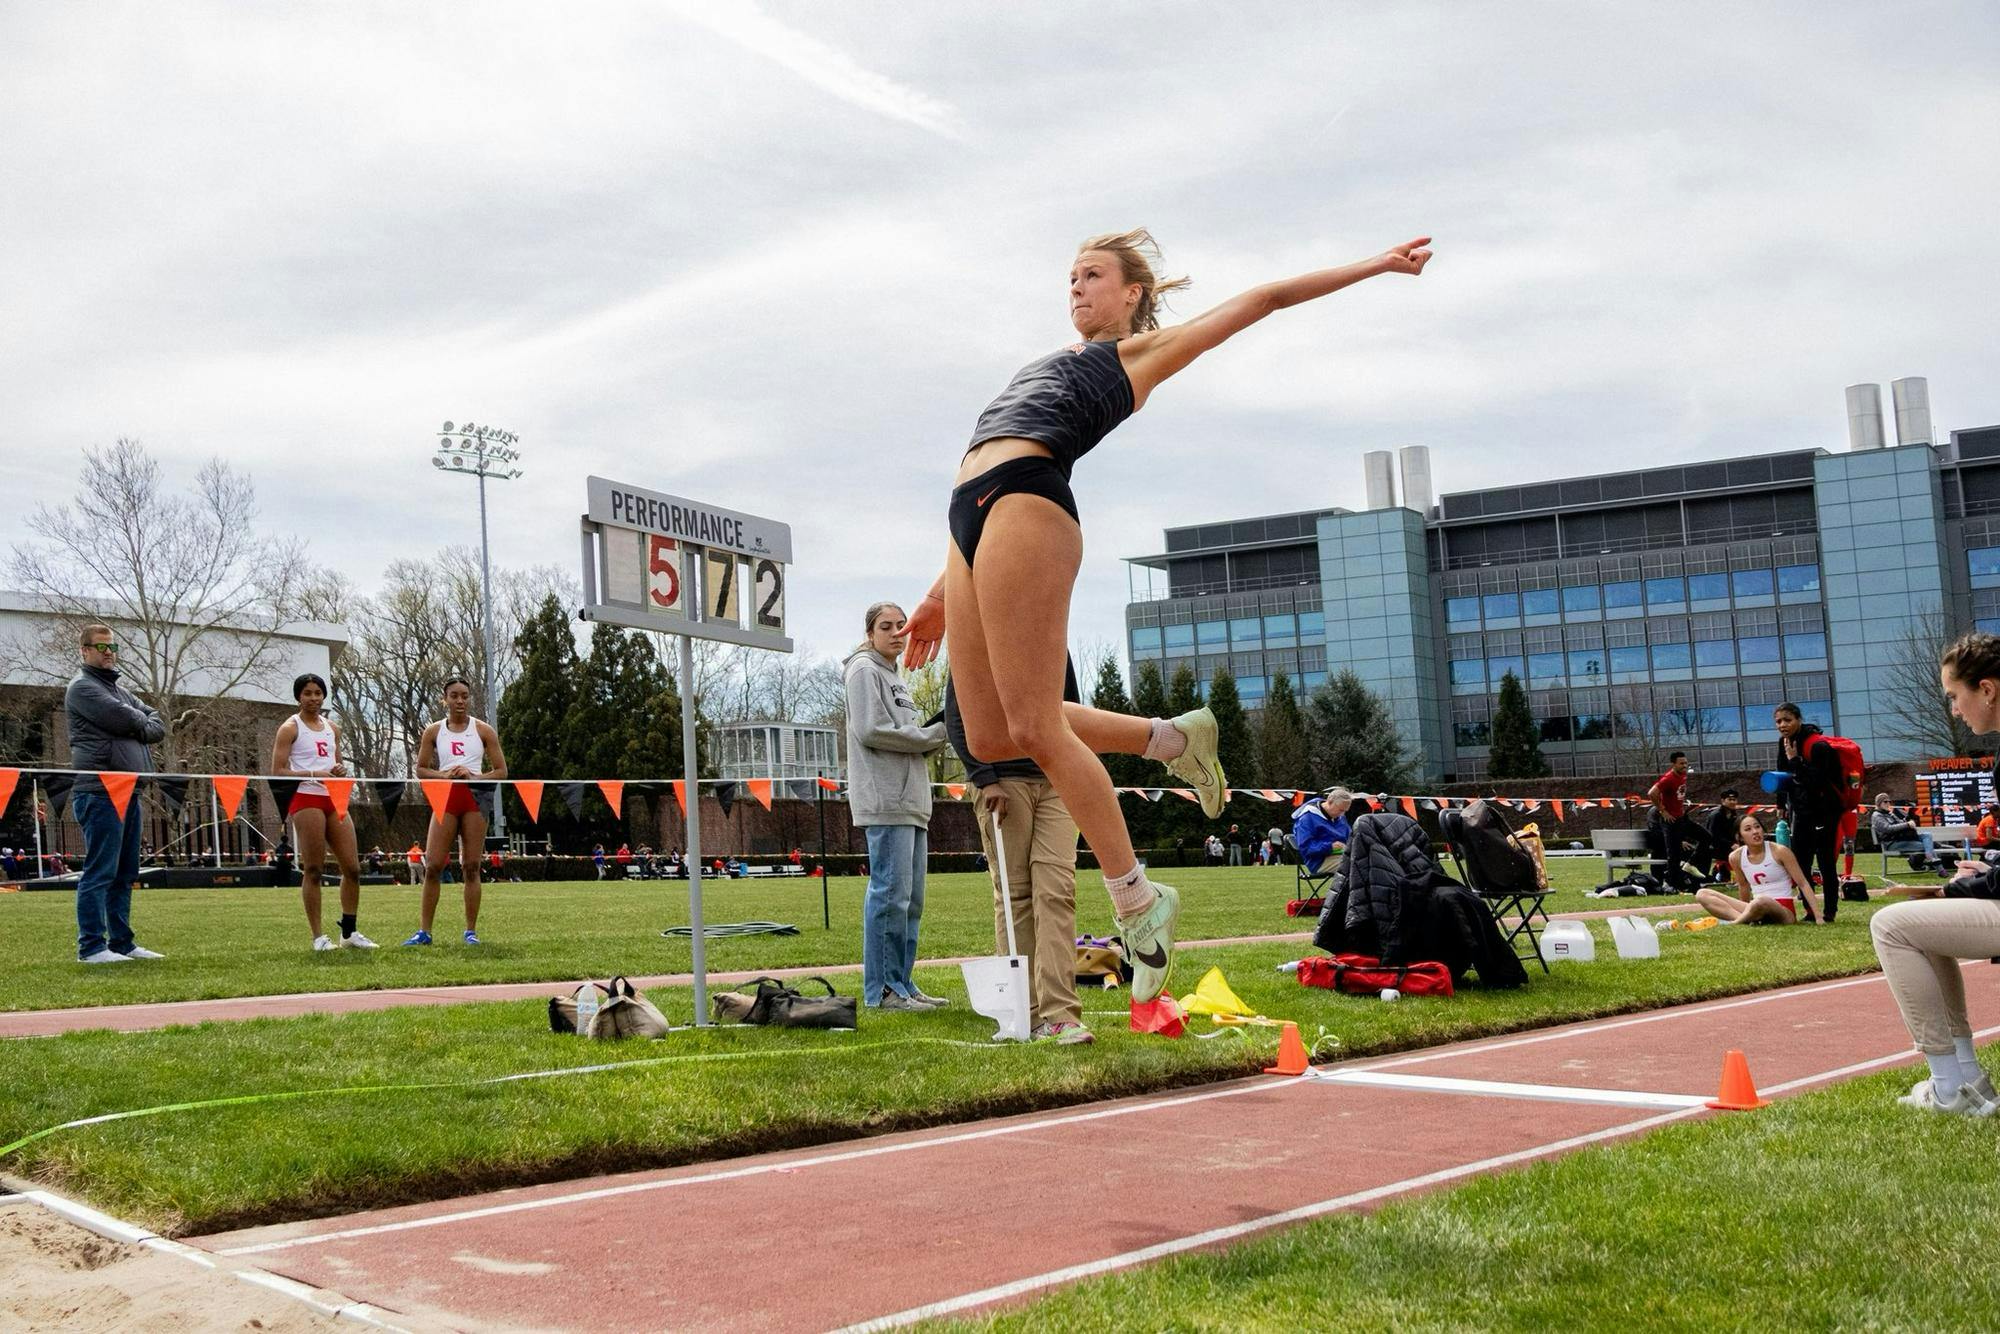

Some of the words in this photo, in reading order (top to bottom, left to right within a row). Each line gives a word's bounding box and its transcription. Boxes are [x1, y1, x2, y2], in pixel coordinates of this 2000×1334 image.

[611, 490, 745, 549] PERFORMANCE
[649, 535, 680, 607] 5
[708, 550, 734, 618] 7
[755, 559, 782, 628] 2
[1929, 757, 1973, 770] WEAVER
[1981, 756, 1995, 768] ST
[1133, 920, 1154, 943] NIKE
